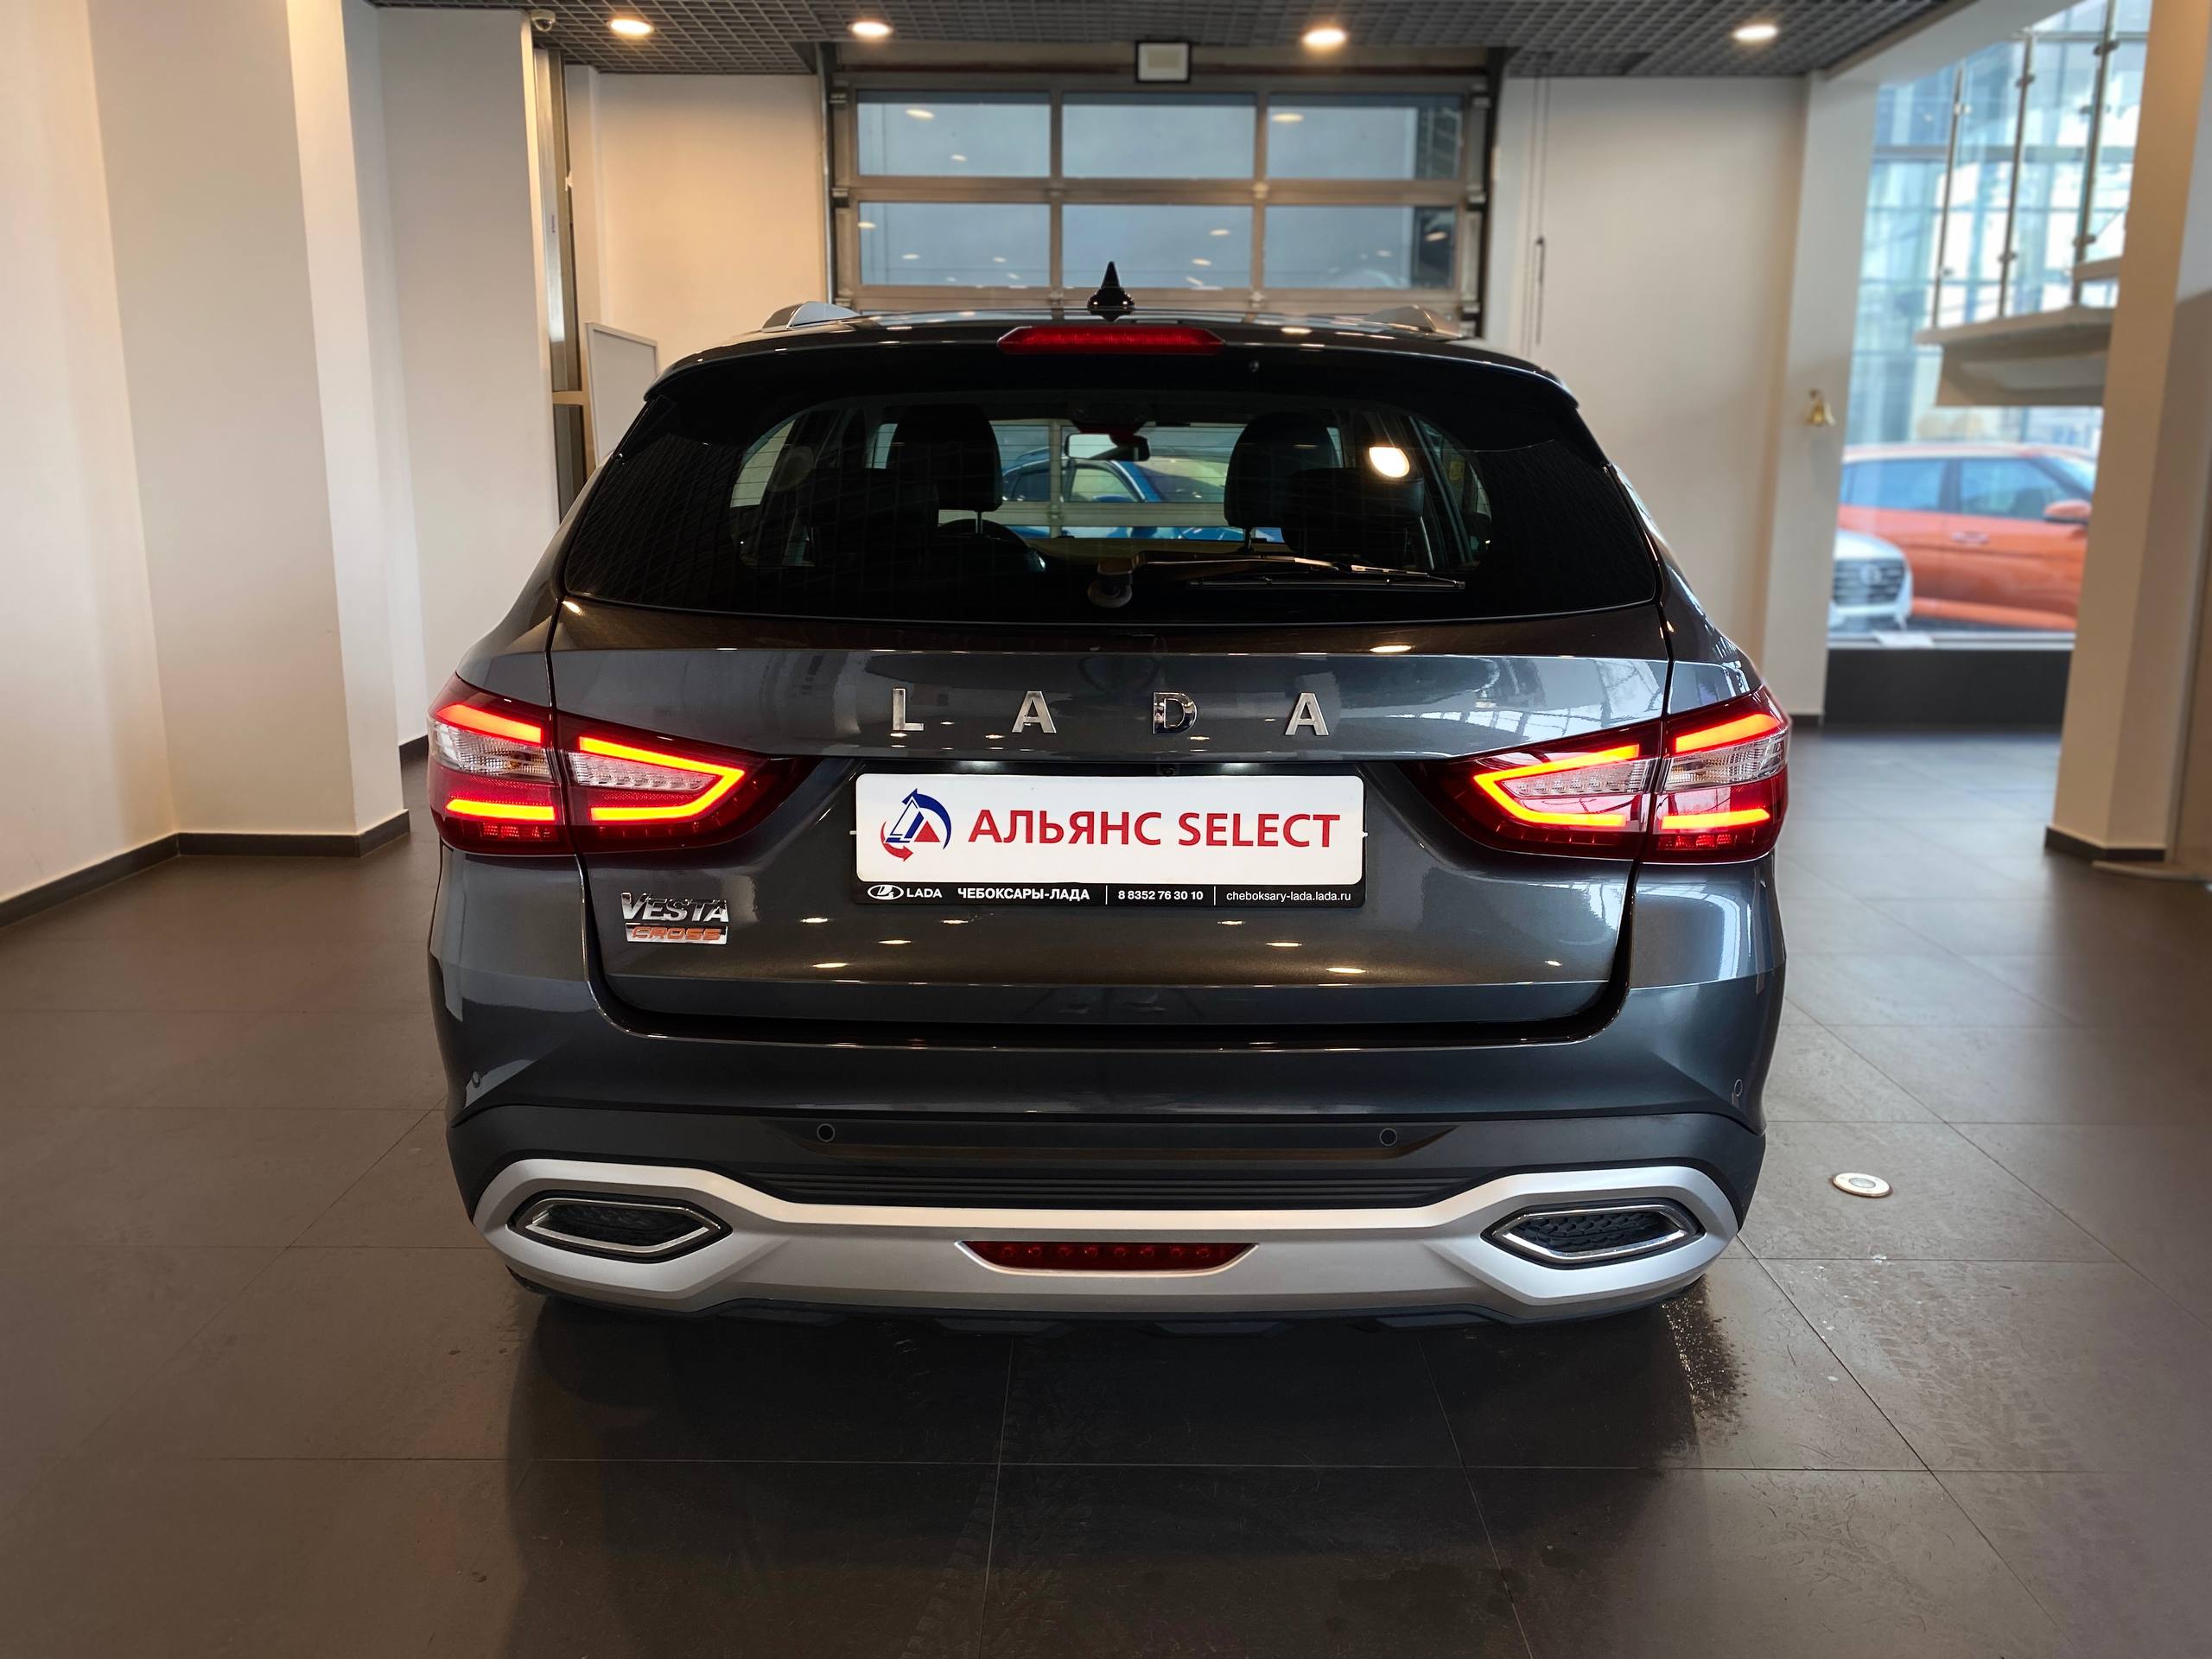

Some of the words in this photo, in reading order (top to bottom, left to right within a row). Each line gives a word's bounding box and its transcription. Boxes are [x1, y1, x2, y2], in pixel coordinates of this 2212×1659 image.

[893, 687, 1329, 736] LADA
[969, 809, 1162, 847] АЛЬЯНС
[1178, 812, 1340, 848] SELECT
[621, 892, 728, 922] VESTA
[906, 888, 943, 898] LADA
[957, 888, 1090, 901] ЧЕБОКСАРЫ-ЛАДА
[1127, 890, 1156, 900] 8352
[1158, 891, 1172, 900] 76
[1173, 891, 1188, 900] 30
[1191, 891, 1204, 900] 10
[1226, 891, 1351, 902] cheboksary-lada.lada.ru
[632, 926, 721, 940] CROSS
